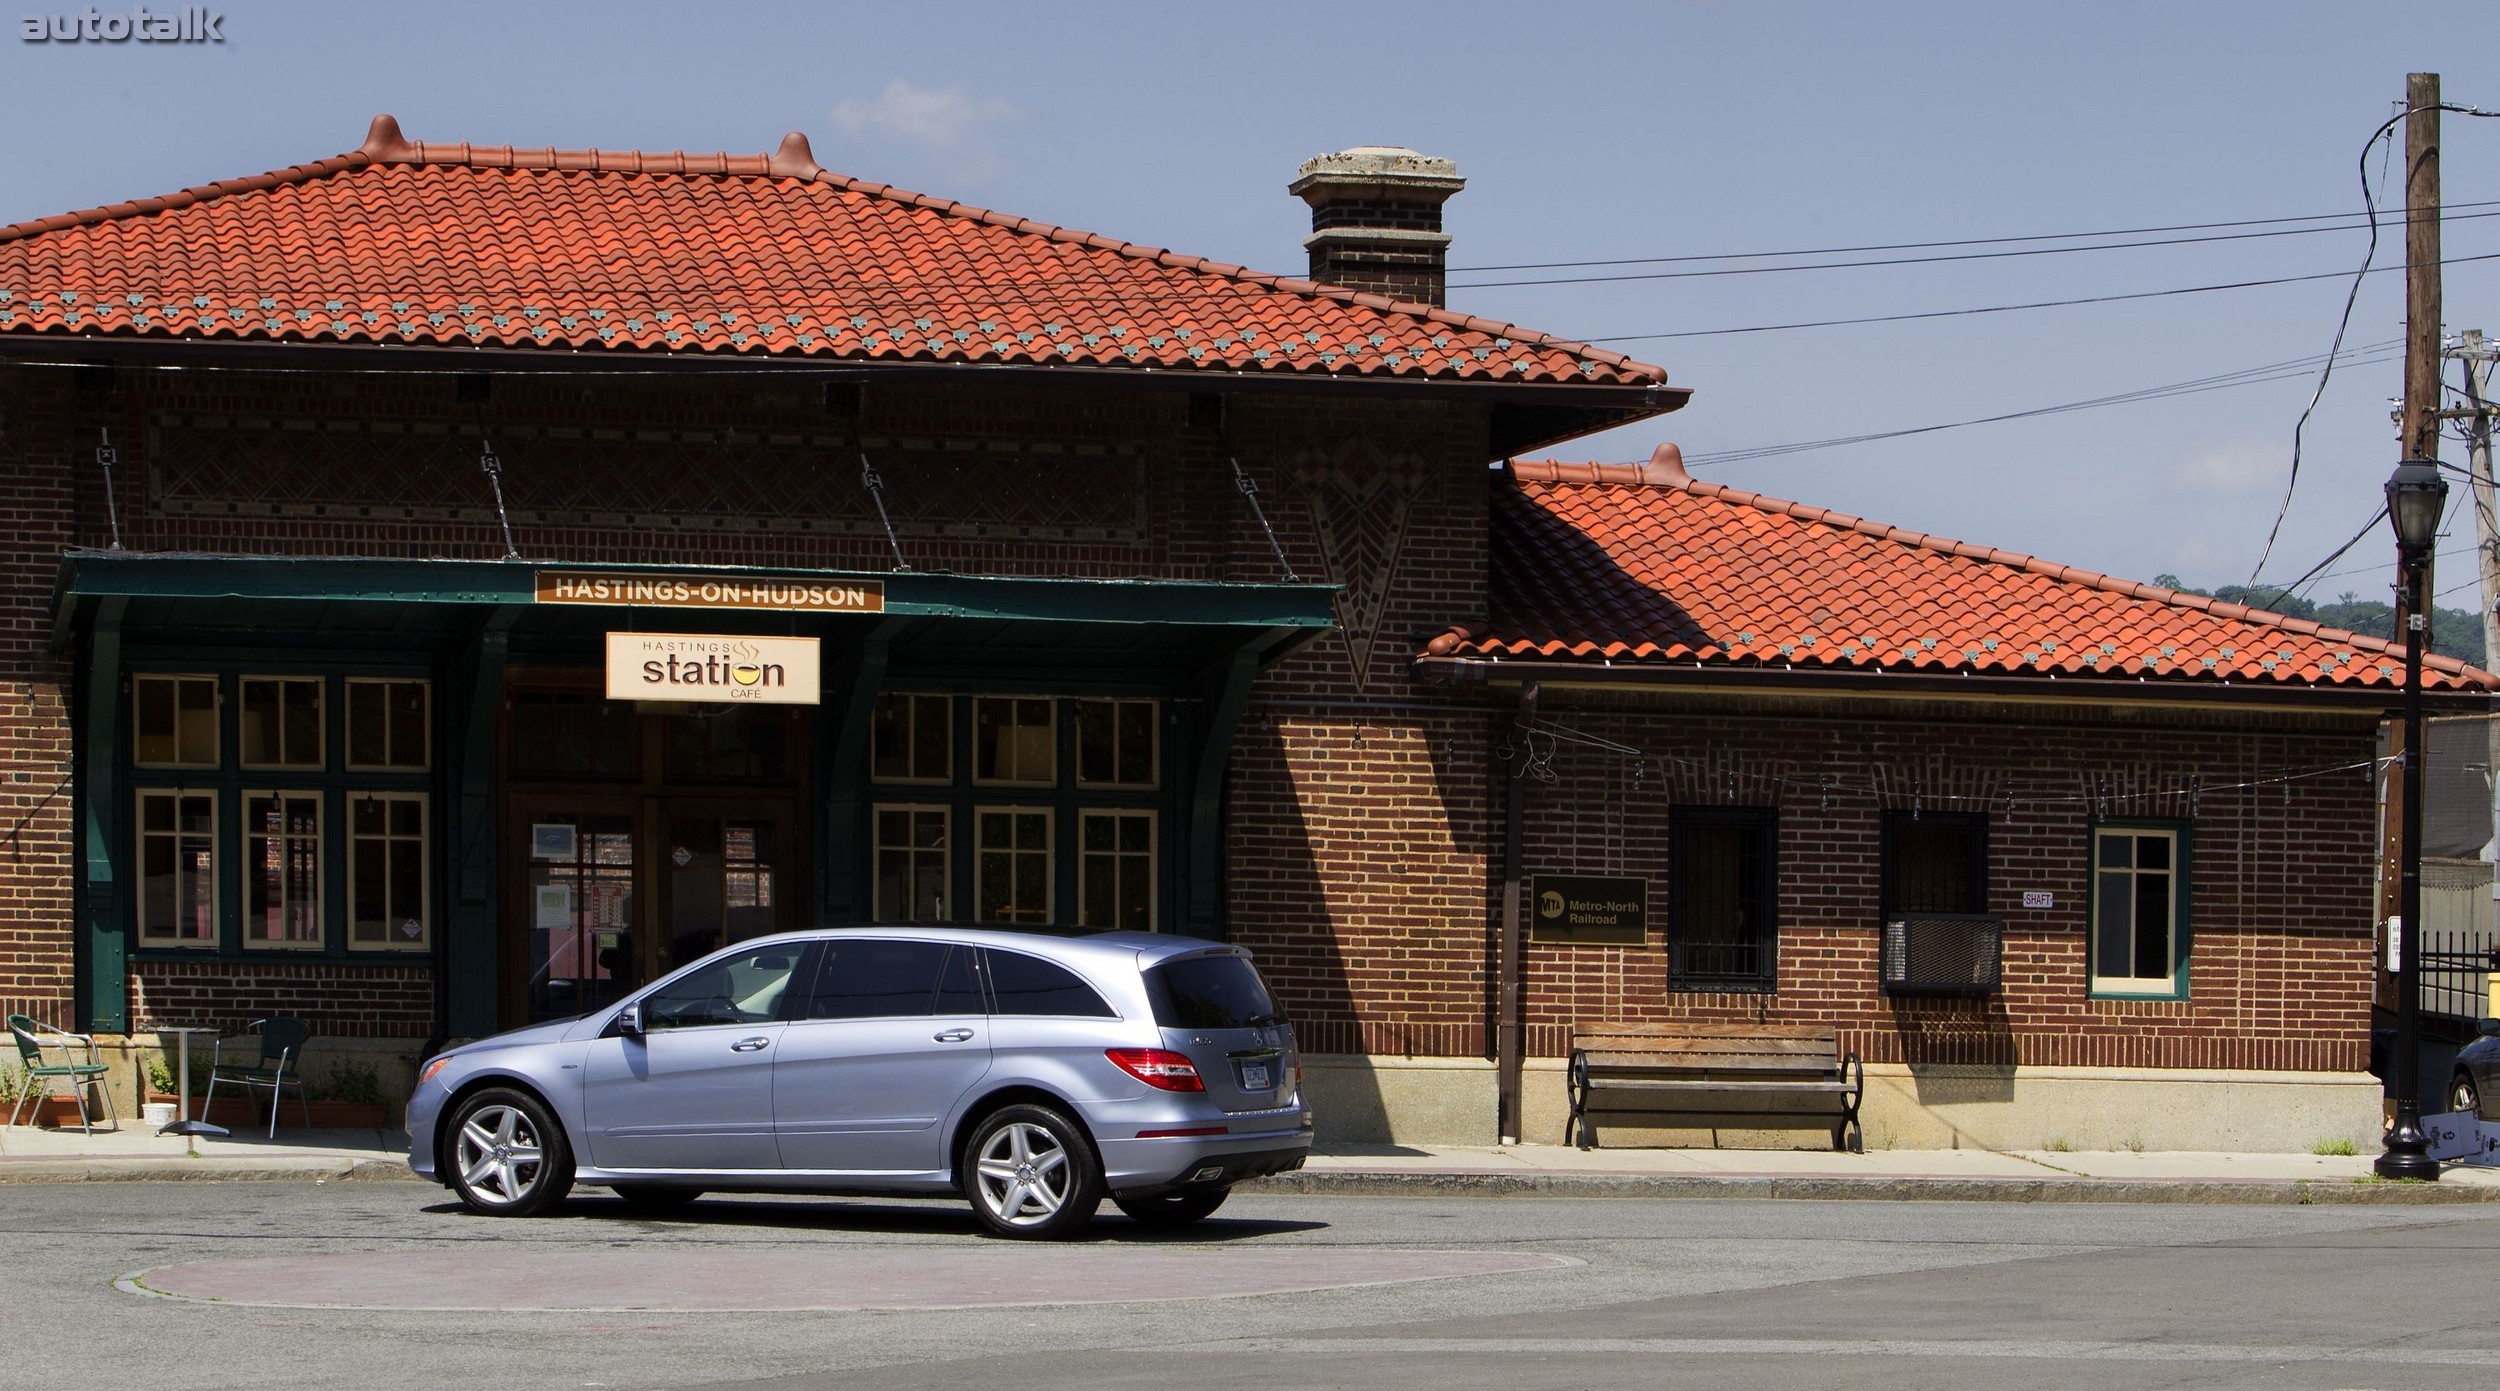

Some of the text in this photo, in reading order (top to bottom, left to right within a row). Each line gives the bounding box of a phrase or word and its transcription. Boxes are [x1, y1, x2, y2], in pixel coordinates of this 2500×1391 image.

[555, 577, 866, 607] HASTINGS-ON-HUDSON
[642, 641, 731, 654] HASTINGS
[642, 653, 785, 688] station
[2026, 893, 2050, 905] SHAFT
[1569, 900, 1639, 912] Metro-North
[1569, 913, 1617, 924] Railroad
